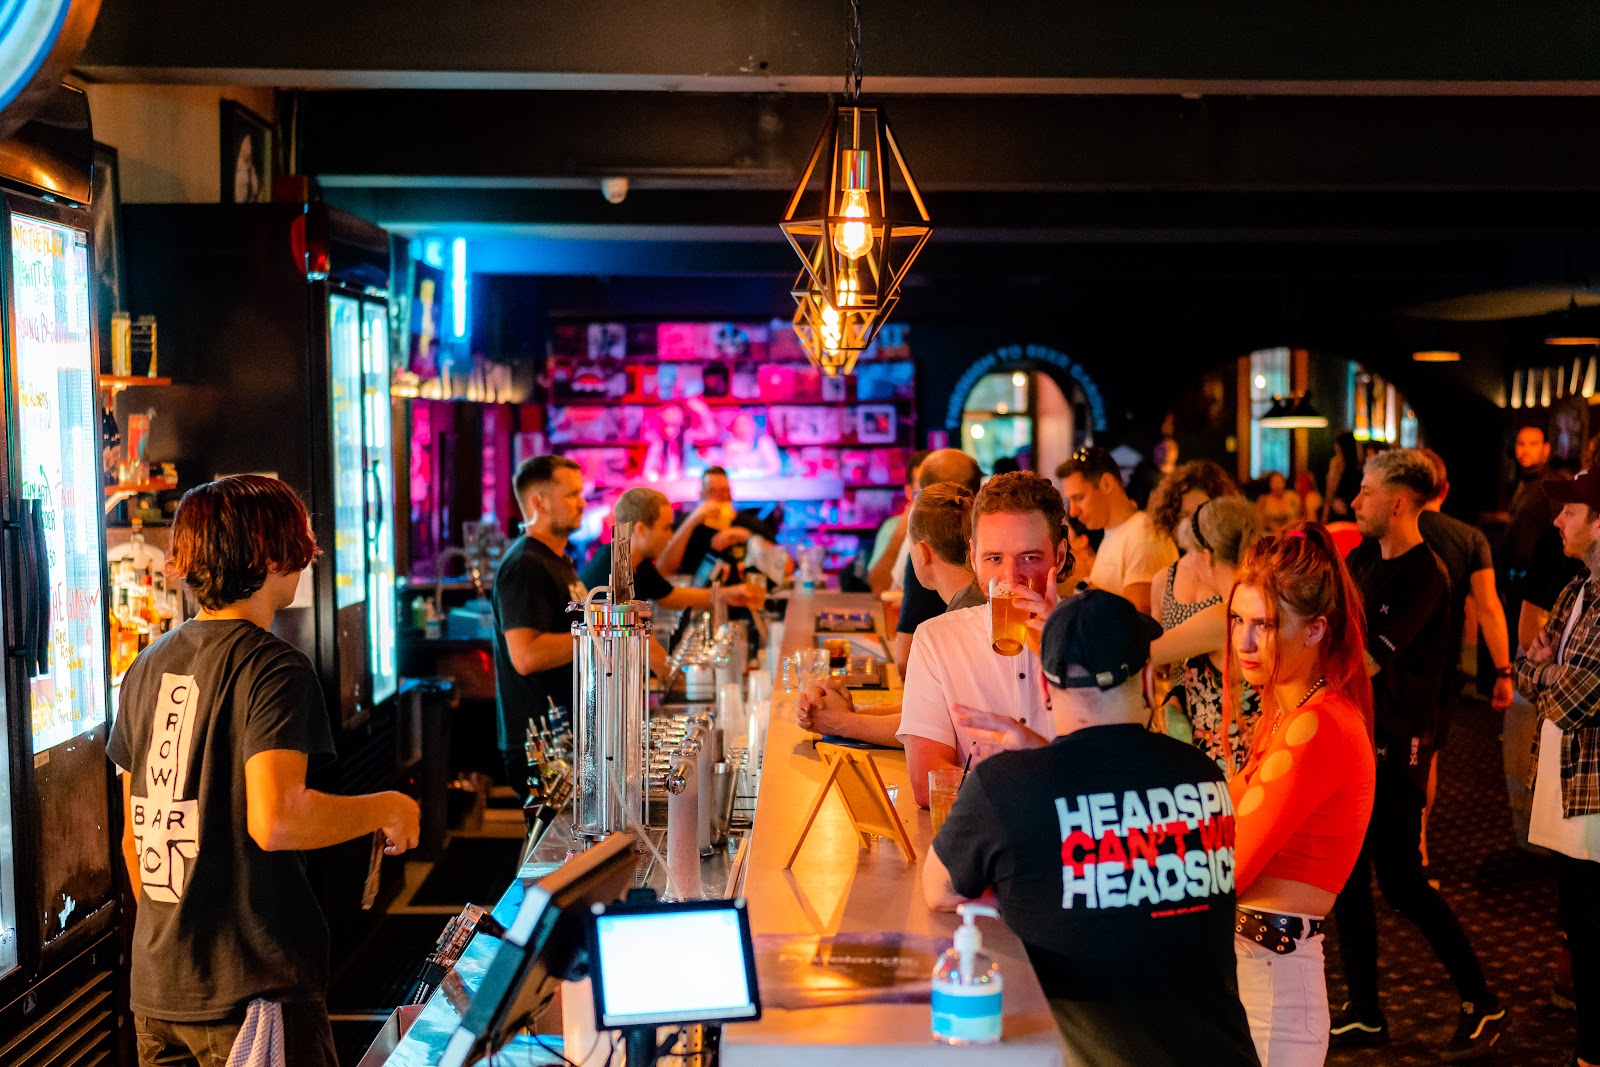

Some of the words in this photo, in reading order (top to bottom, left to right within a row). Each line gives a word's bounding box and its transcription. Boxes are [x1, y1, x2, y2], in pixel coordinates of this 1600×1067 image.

[150, 685, 188, 787] CROW
[134, 805, 185, 830] BAR
[1061, 820, 1191, 877] CAN'T
